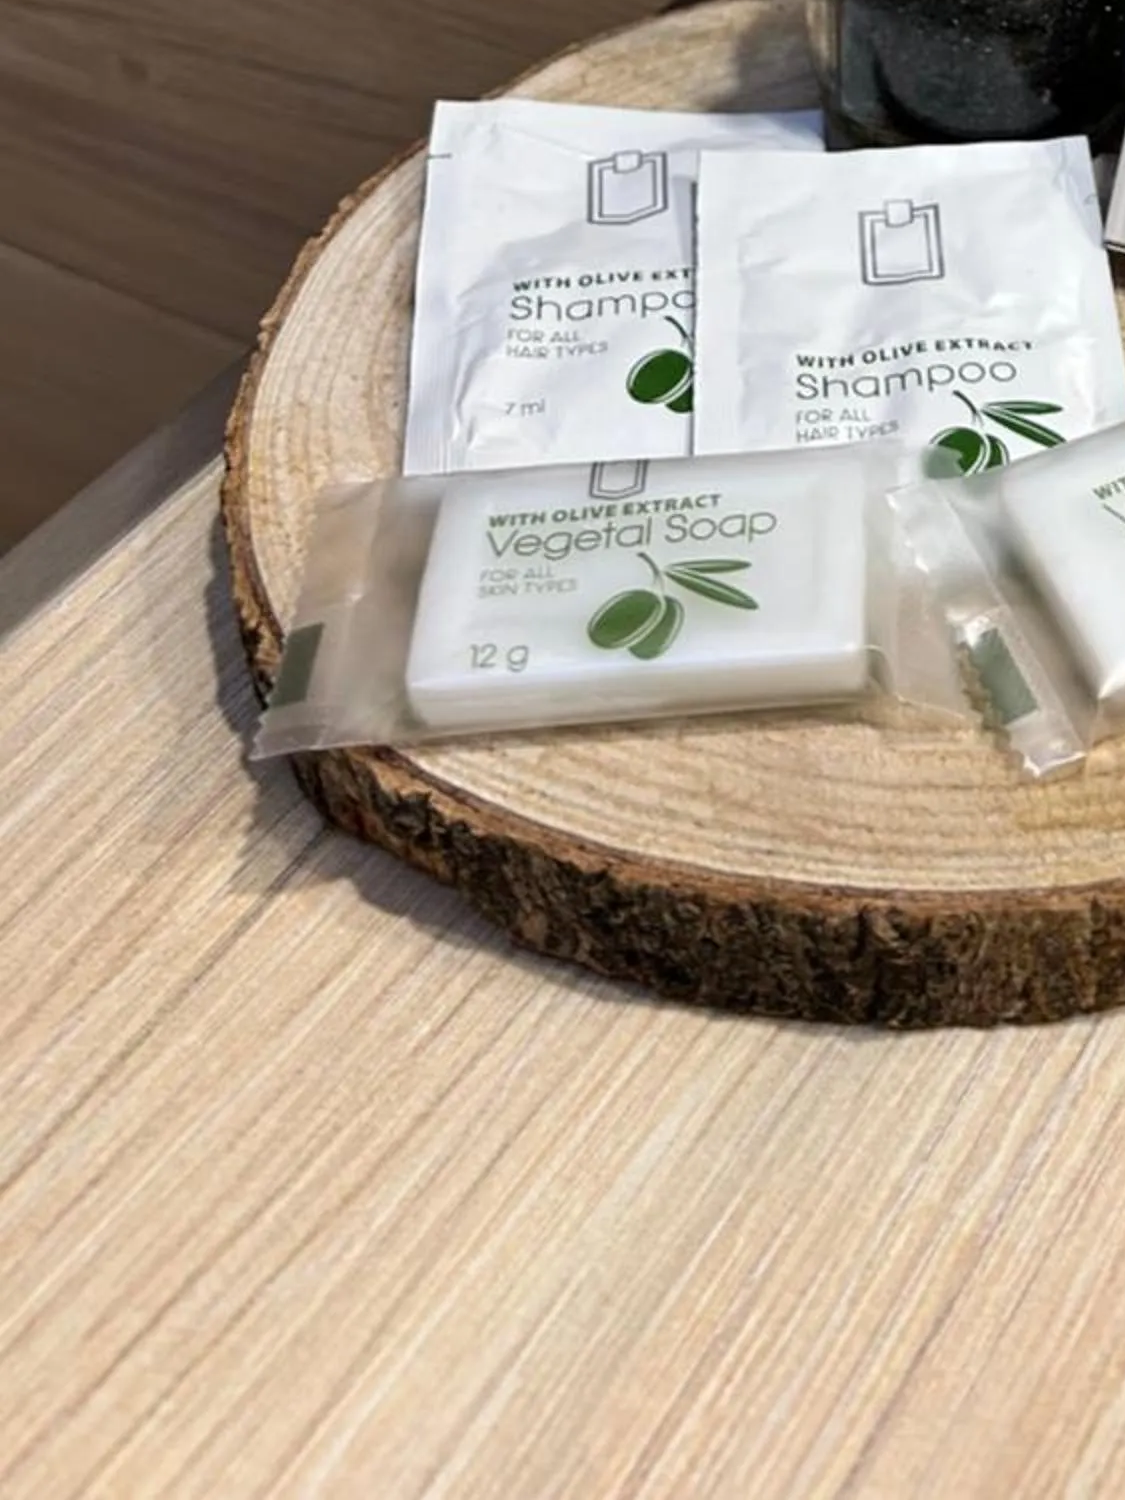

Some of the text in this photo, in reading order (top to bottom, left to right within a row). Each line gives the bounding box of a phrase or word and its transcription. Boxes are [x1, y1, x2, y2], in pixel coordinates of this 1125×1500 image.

[513, 276, 571, 293] WITH
[578, 271, 643, 288] OLIVE
[509, 290, 696, 321] Shampo
[507, 327, 581, 344] FOR ALL
[506, 344, 549, 360] HAIR
[796, 337, 1033, 369] WITH OLIVE EXTRACT
[795, 361, 1017, 401] Shampoo
[504, 399, 546, 417] 7 ml
[796, 407, 872, 425] FOR ALL
[796, 425, 839, 444] HAIR
[488, 493, 723, 528] WITH OLIVE EXTRACT
[486, 511, 778, 562] Vegetal Soap
[523, 565, 556, 579] ALL
[470, 643, 530, 674] 12 g
